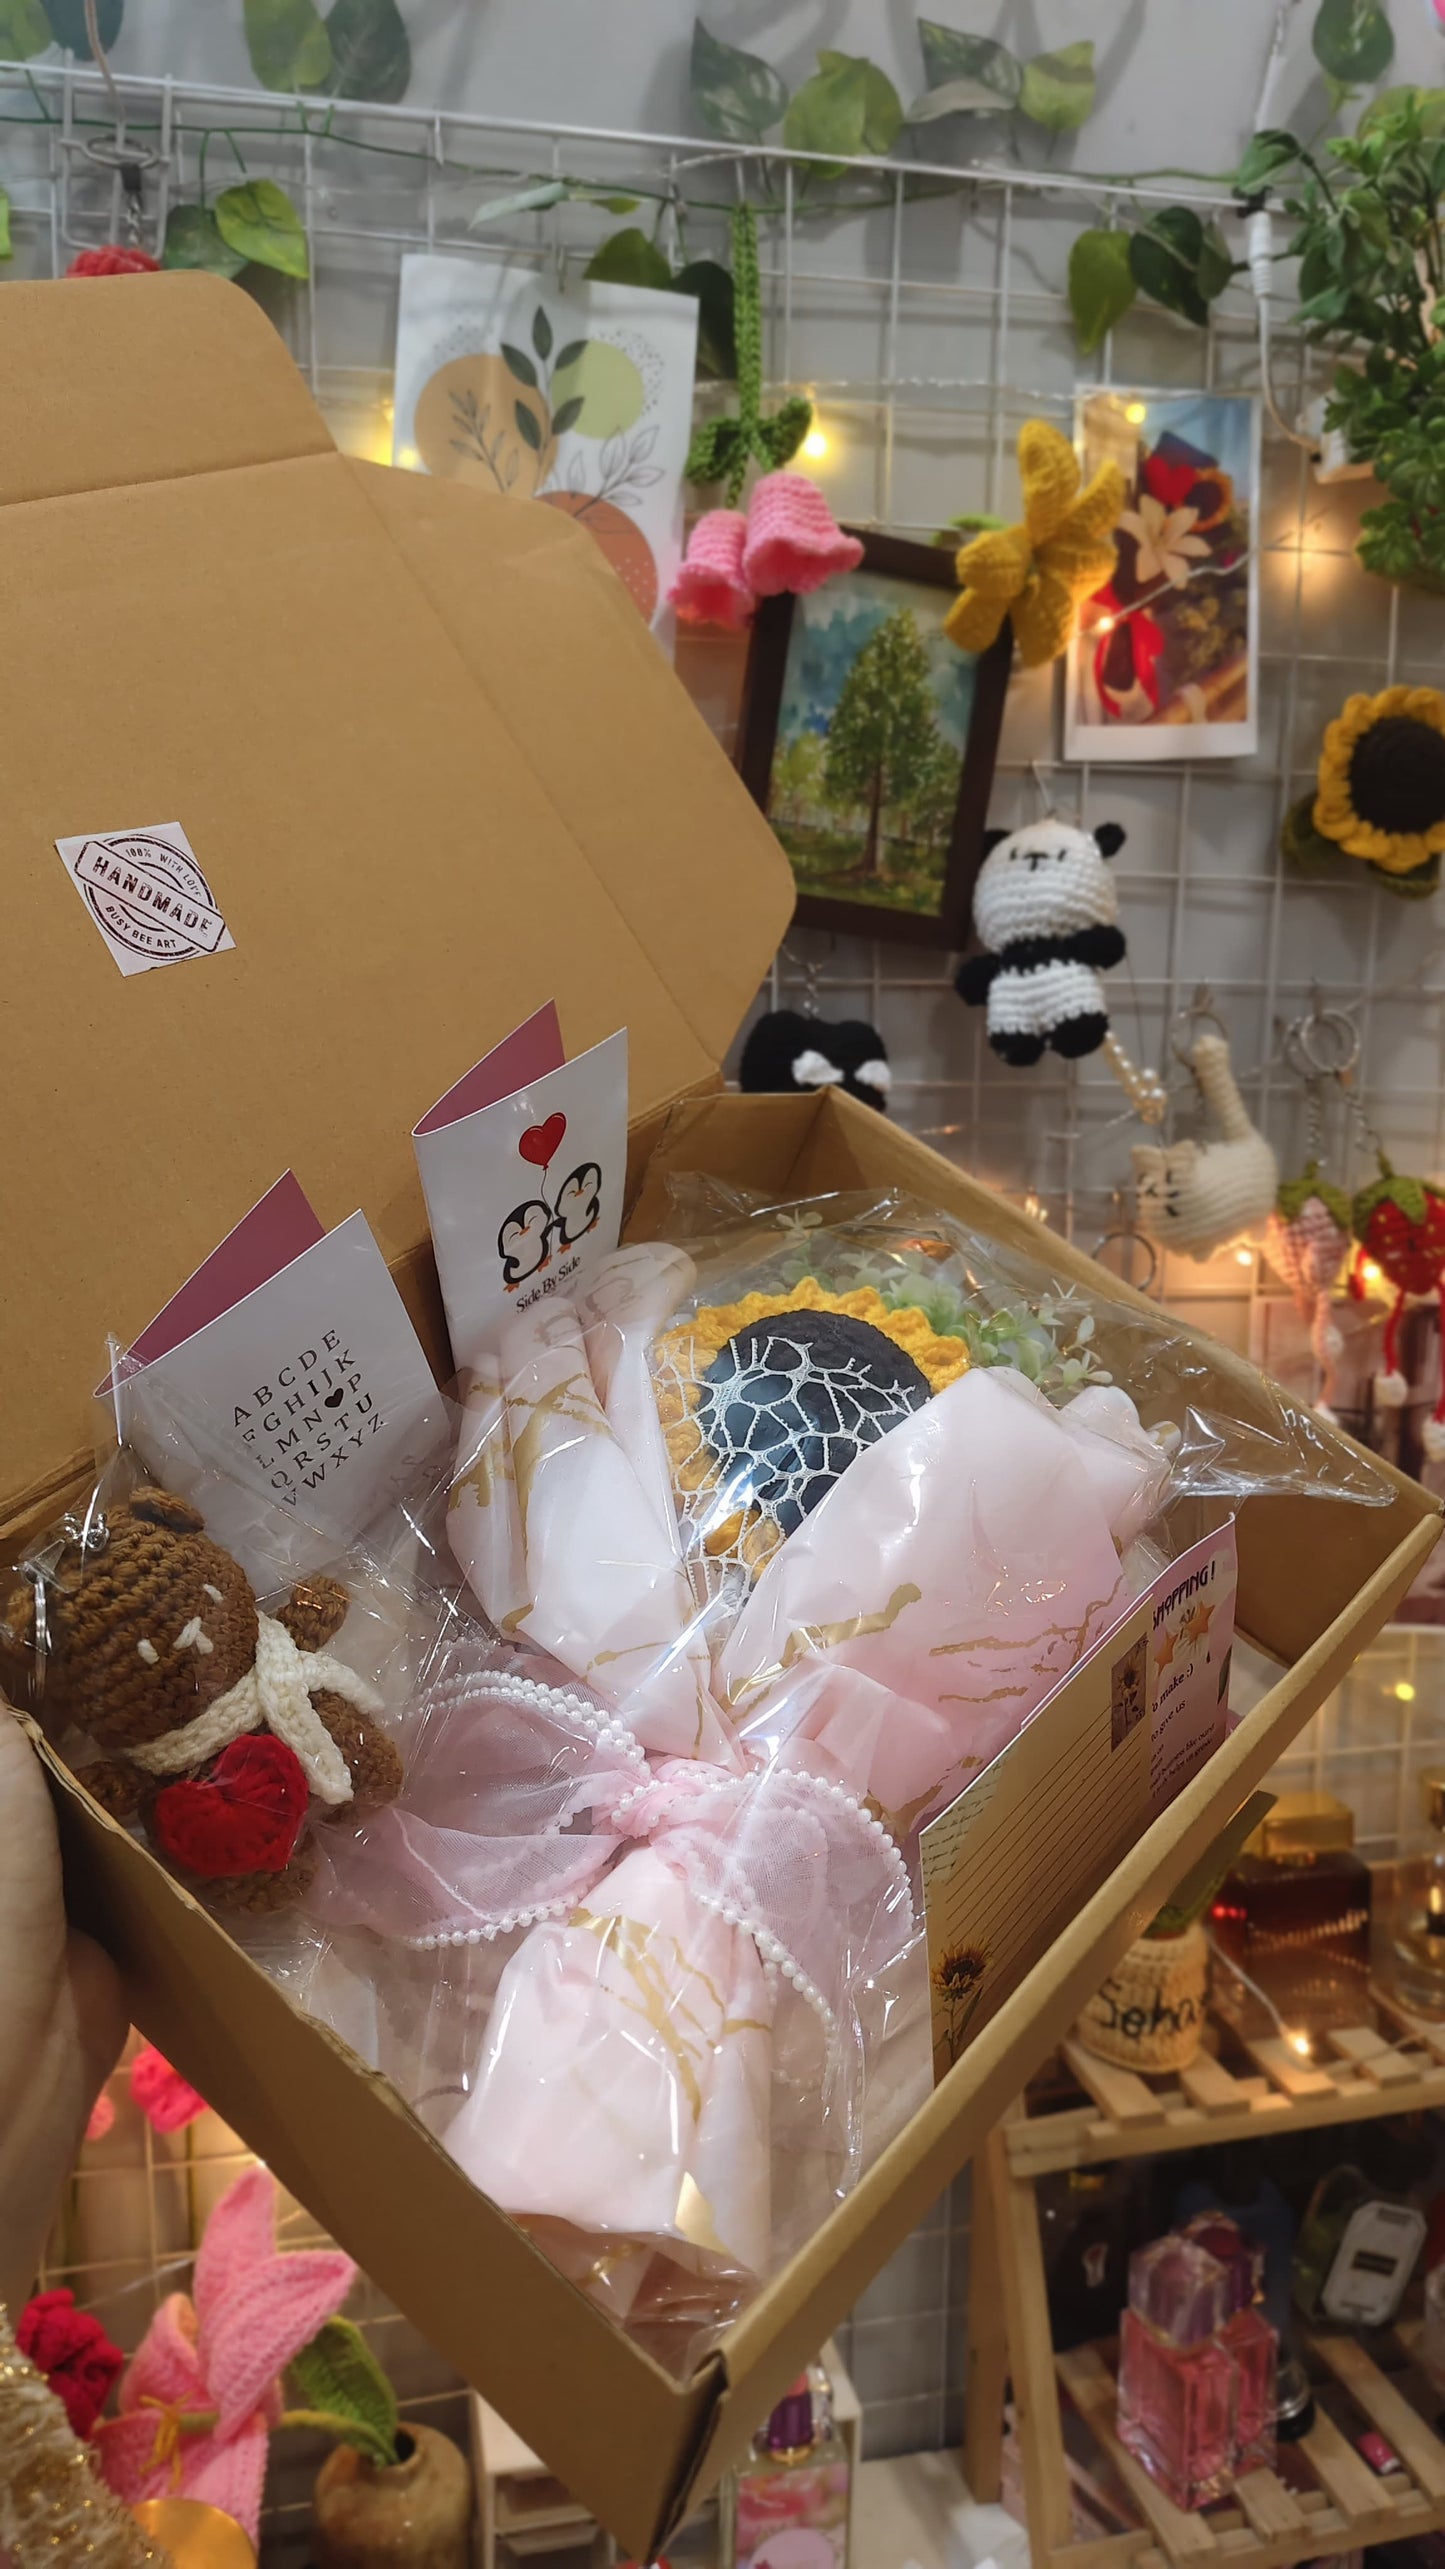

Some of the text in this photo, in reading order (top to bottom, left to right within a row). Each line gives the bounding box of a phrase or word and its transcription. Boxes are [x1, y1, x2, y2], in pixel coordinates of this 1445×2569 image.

[125, 847, 152, 858] 100%
[159, 853, 184, 874] WITH
[92, 855, 213, 938] HANDMADE
[105, 905, 177, 949] BUSY BEE ART
[516, 1256, 581, 1314] Side By Side
[1151, 1701, 1158, 1712] o
[1160, 1673, 1185, 1706] make
